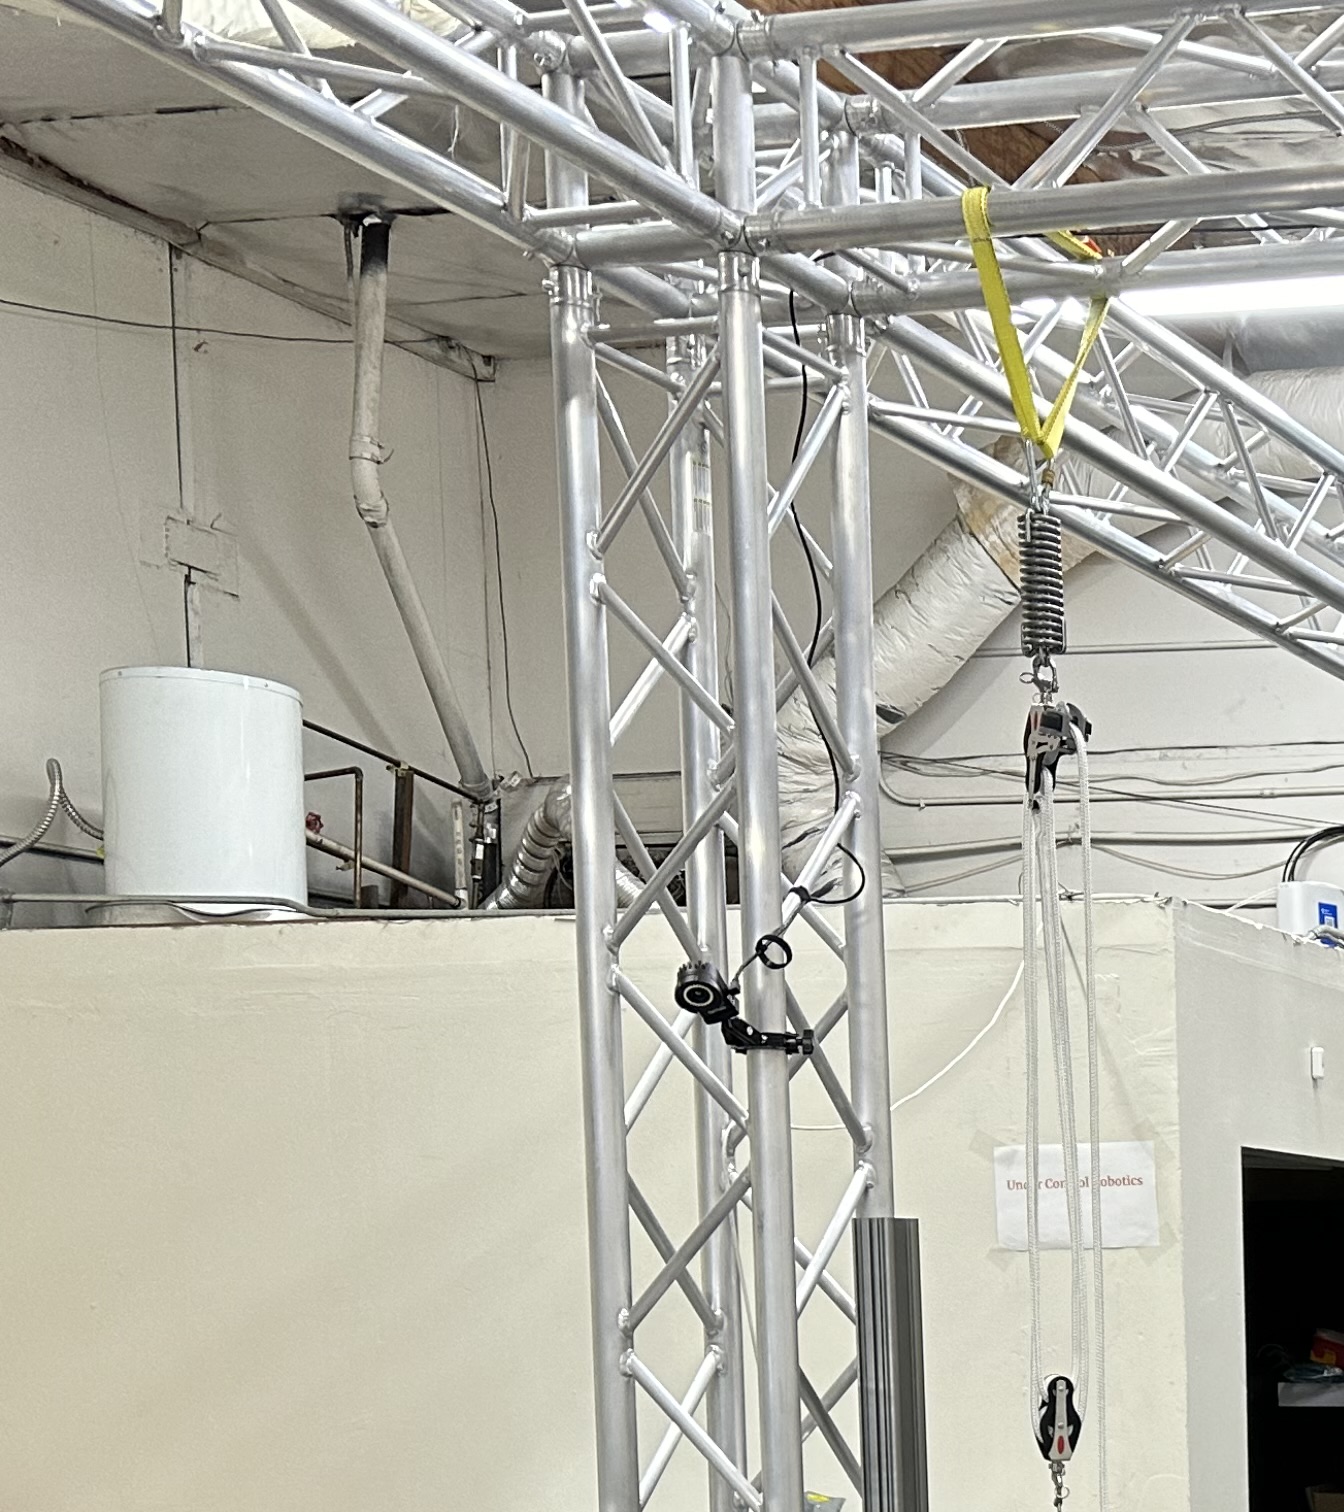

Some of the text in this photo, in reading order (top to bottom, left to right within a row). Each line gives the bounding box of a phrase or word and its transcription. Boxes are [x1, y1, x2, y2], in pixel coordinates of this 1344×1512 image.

[1006, 1174, 1144, 1191] Unr Conol obotics
